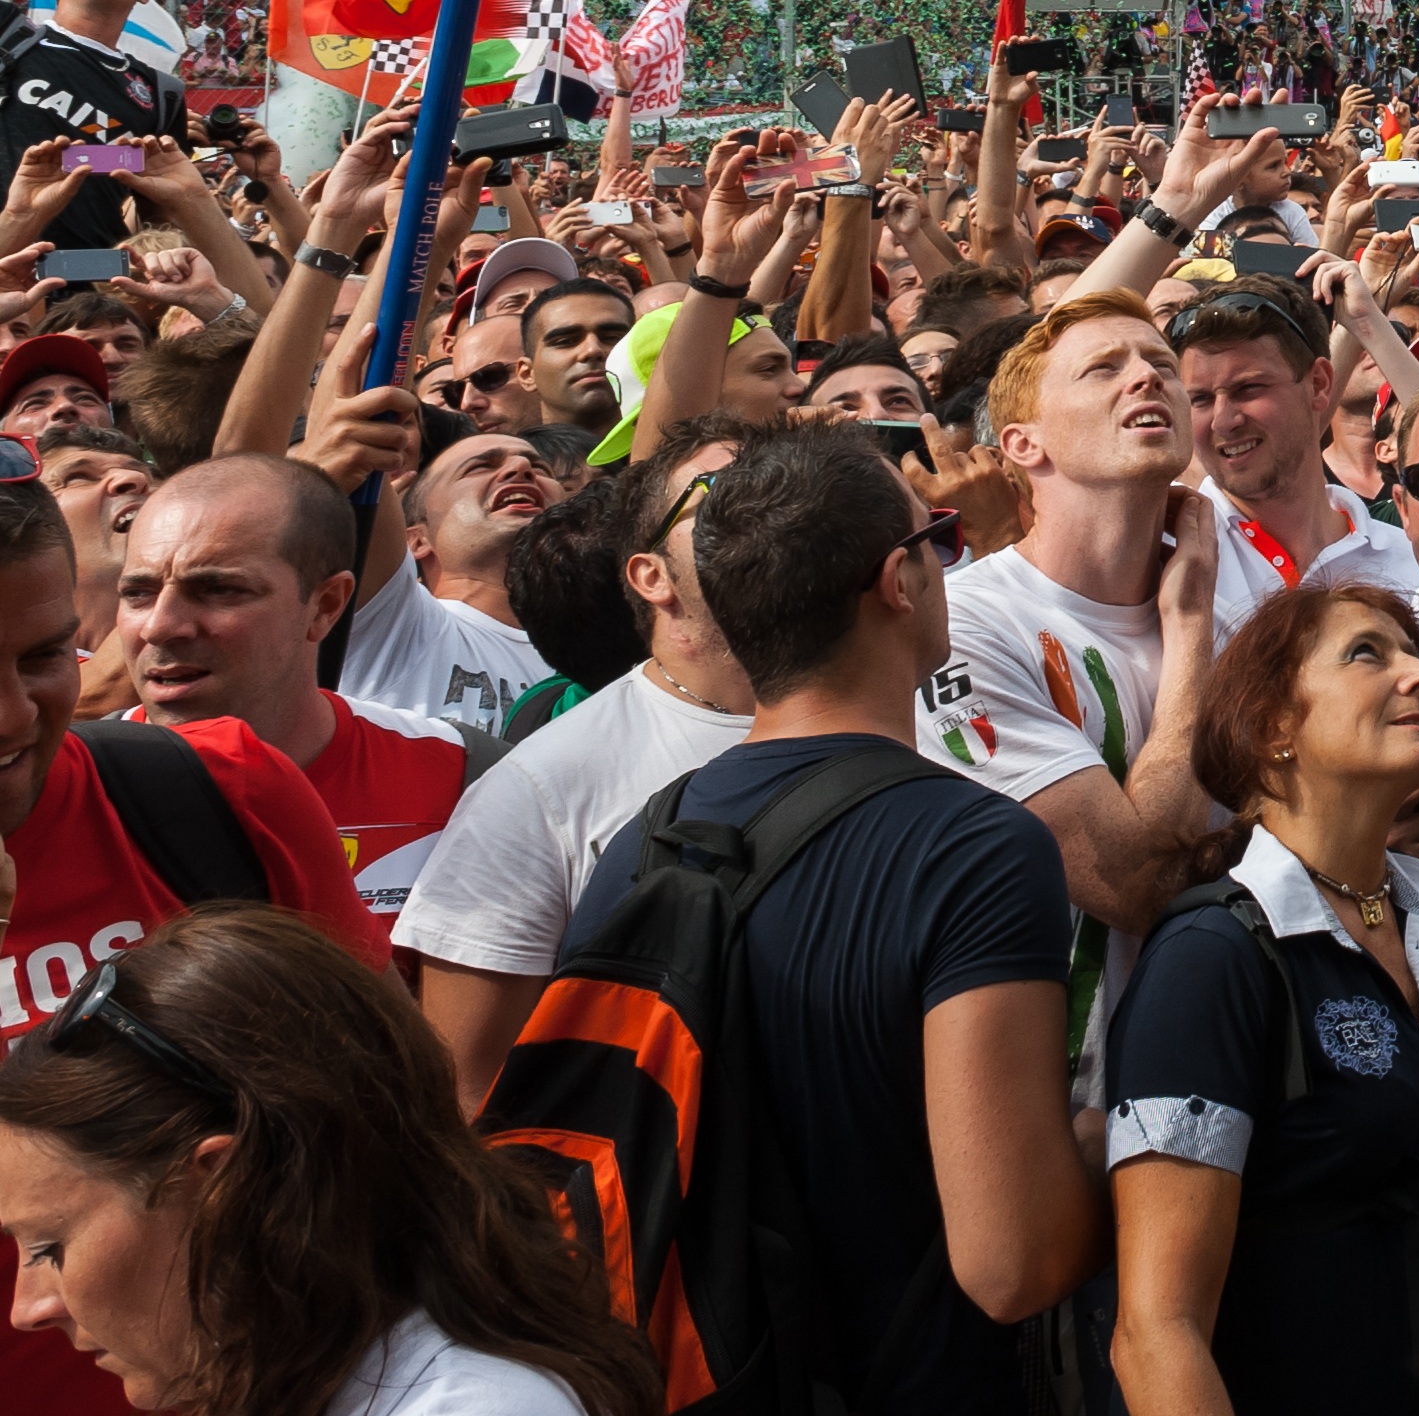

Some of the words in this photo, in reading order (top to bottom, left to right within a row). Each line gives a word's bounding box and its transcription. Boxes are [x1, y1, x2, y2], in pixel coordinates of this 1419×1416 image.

[18, 79, 133, 145] CAIX
[407, 234, 434, 293] MATCH
[422, 181, 443, 225] POLE
